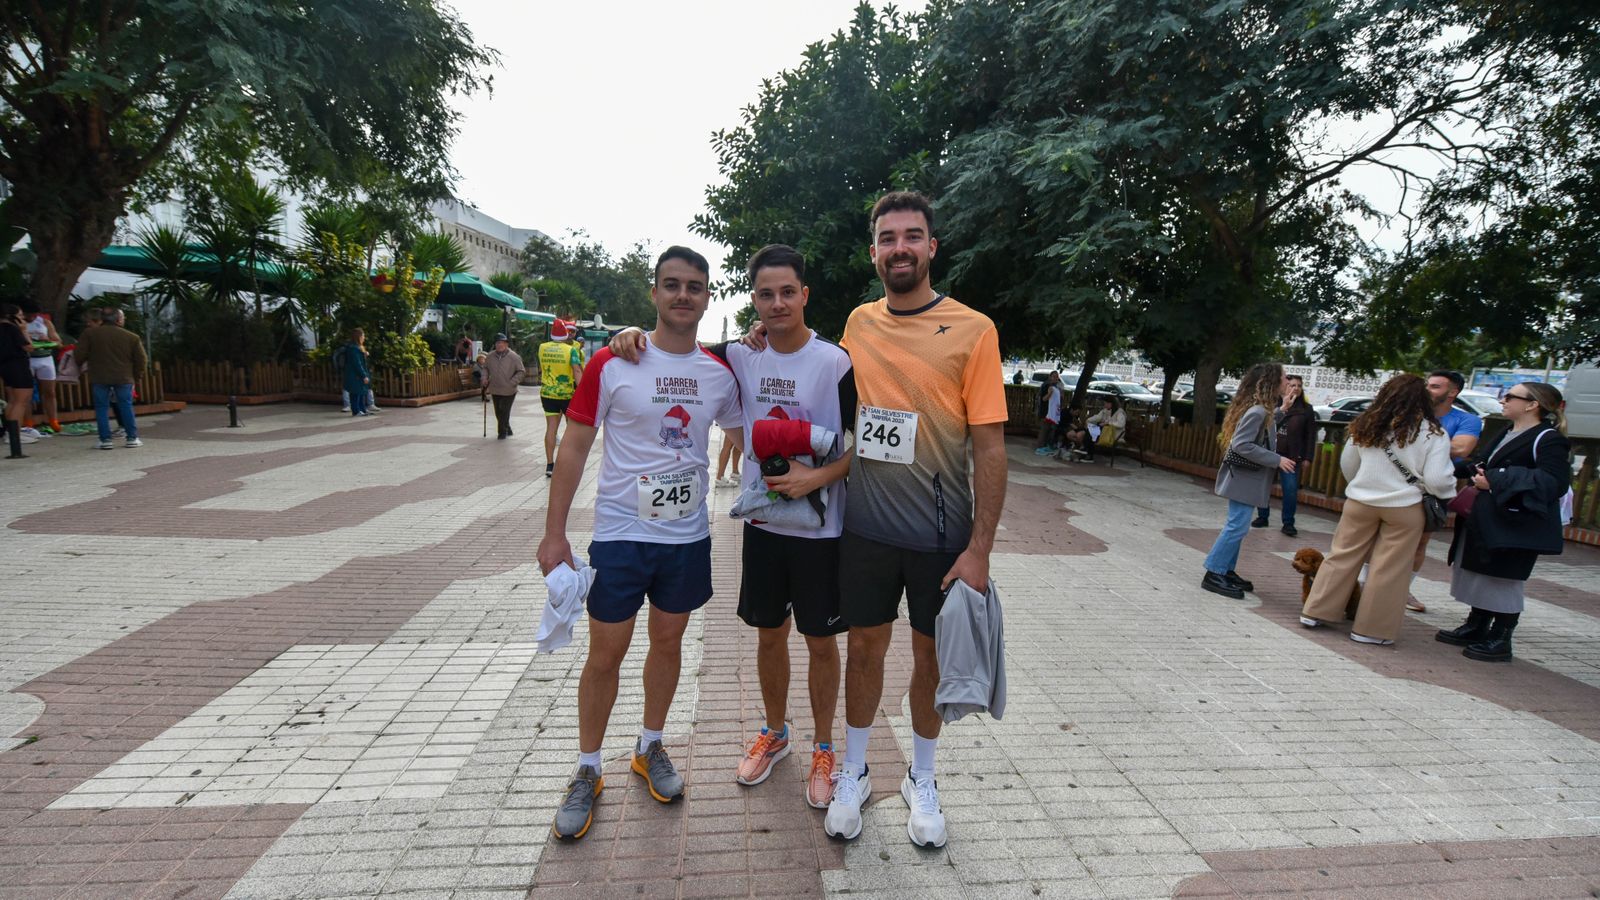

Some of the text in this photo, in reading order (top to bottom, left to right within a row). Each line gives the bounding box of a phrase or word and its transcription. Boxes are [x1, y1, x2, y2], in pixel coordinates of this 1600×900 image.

[656, 377, 698, 388] II CARRERA
[760, 377, 765, 386] II
[670, 387, 699, 396] SILVESTRE
[881, 409, 913, 419] SILVESTRE
[862, 421, 901, 447] 246
[672, 470, 696, 478] SILVESTRE
[652, 484, 691, 507] 245
